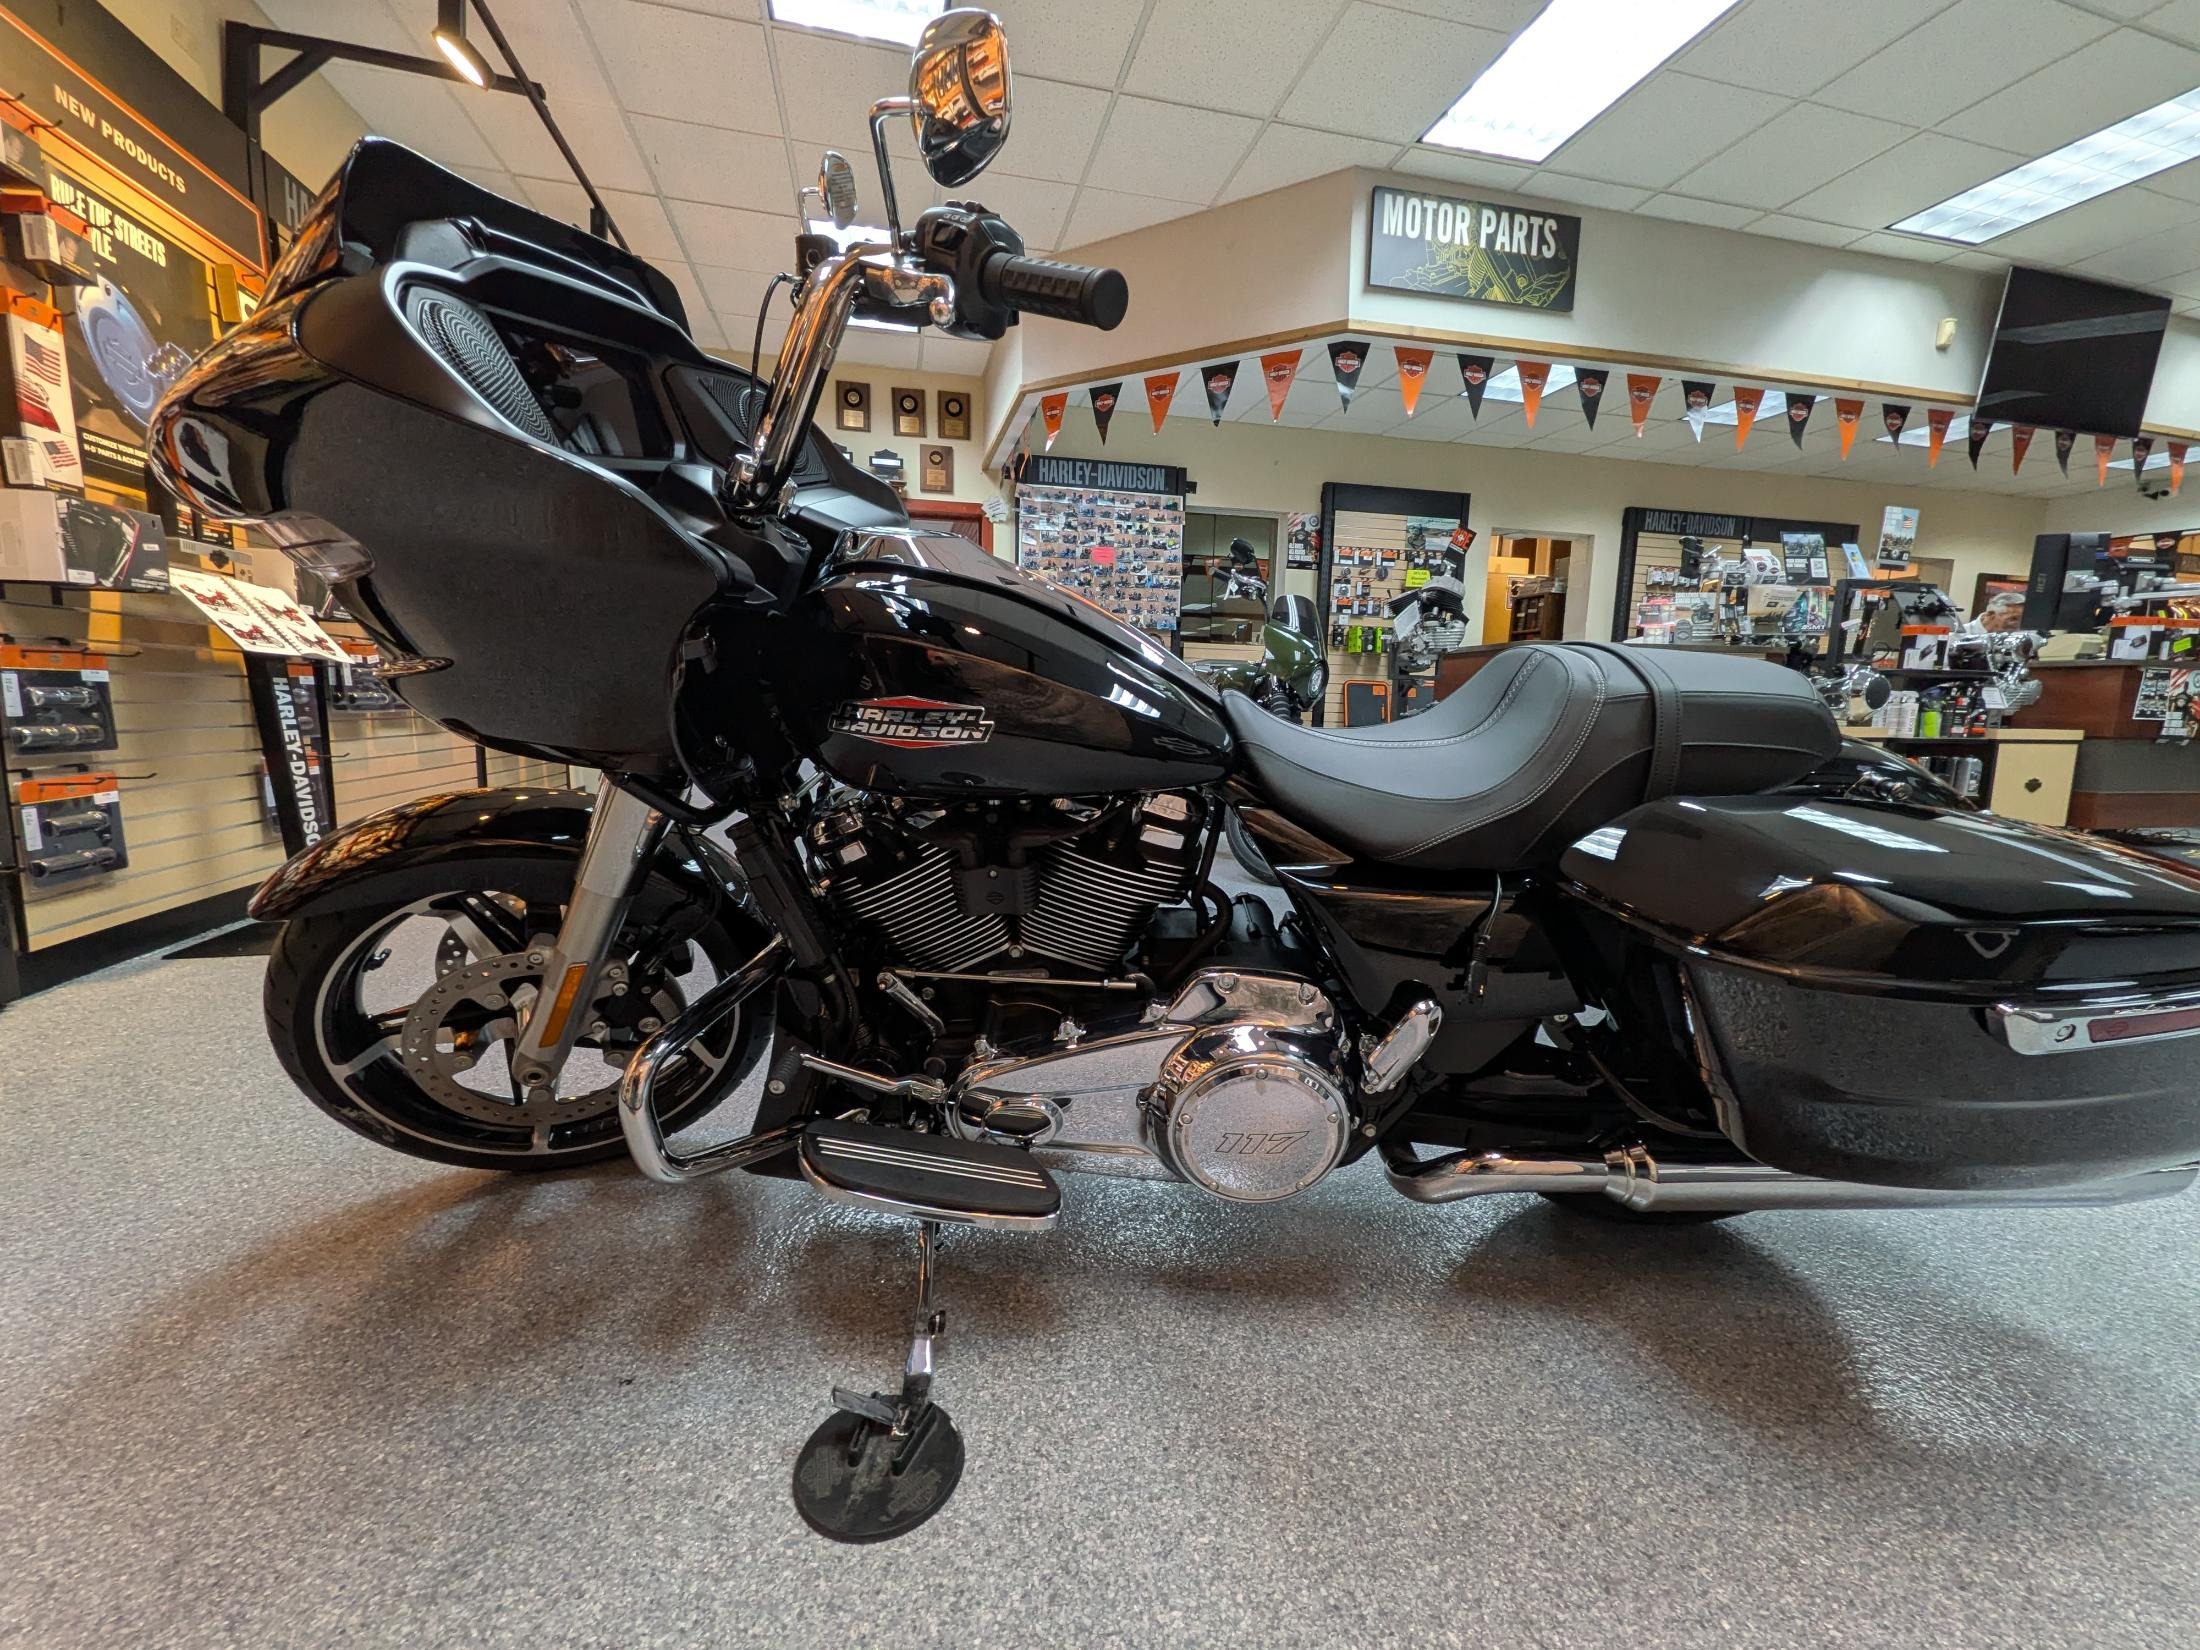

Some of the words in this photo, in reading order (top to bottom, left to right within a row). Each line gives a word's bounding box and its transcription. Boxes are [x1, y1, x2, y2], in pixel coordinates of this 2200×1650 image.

[54, 84, 95, 128] NEW
[101, 119, 186, 193] PRODUCTS
[51, 173, 87, 219] RULE
[113, 214, 166, 267] STREETS
[1382, 193, 1471, 246] MOTOR
[1480, 208, 1558, 259] PARTS
[1039, 458, 1166, 491] HARLEY-DAVIDSON
[1644, 510, 1736, 537] HARLEY-DAVIDSON
[832, 719, 985, 739] DAVIDSON
[272, 677, 322, 847] HARLEY-DAVIDSO
[1215, 1131, 1310, 1154] 117
